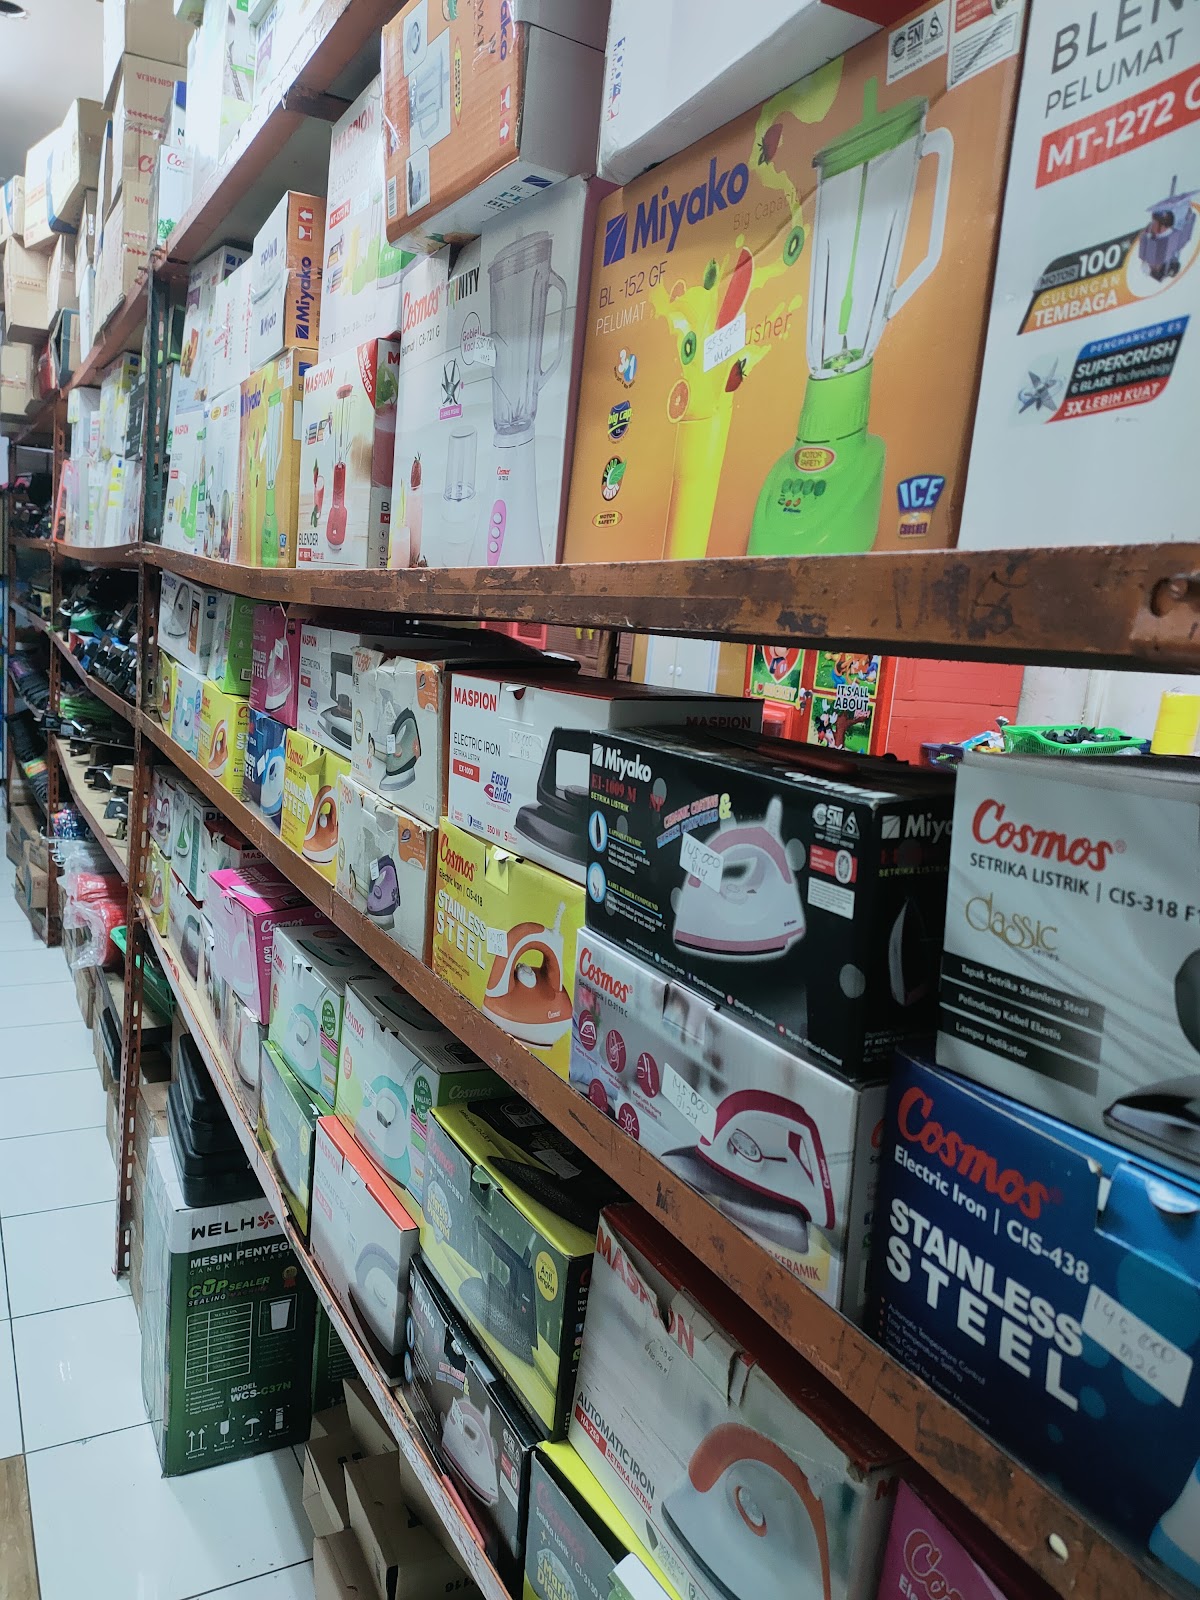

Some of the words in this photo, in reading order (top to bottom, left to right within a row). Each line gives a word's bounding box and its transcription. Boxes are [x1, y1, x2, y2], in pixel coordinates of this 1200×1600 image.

[1045, 27, 1184, 119] PELUMAT
[1046, 91, 1176, 173] MT-1272
[631, 156, 749, 254] Miyako
[296, 256, 314, 322] Miyako
[599, 285, 616, 309] BL
[647, 260, 668, 289] GF
[402, 290, 440, 336] Cosmos
[596, 301, 648, 336] PELUMAT
[1034, 290, 1119, 327] TEMBAGA
[745, 312, 793, 346] usher
[1075, 339, 1177, 379] SUPERCRUSH
[305, 367, 336, 395] MASPION
[1080, 372, 1114, 393] BLADE
[1064, 400, 1084, 417] 3X
[1085, 390, 1122, 411] LEBIH
[1124, 382, 1161, 401] KUAT
[801, 450, 823, 460] MOTOR
[801, 458, 821, 468] SAFETY
[899, 477, 945, 508] ICE
[298, 532, 319, 546] BLENDER
[598, 518, 615, 526] SAFETY
[454, 687, 497, 712] MASPION
[834, 698, 869, 712] ABOUT
[836, 685, 853, 698] IT'S
[854, 686, 869, 698] ALL
[686, 716, 751, 729] MASPION
[454, 732, 482, 752] ELECTRIC
[483, 741, 501, 757] IRON
[491, 771, 510, 790] Easy
[604, 747, 652, 784] Miyako
[494, 786, 512, 805] Glide
[590, 792, 610, 806] SETRIKA
[611, 798, 630, 813] LISTRIK
[826, 809, 844, 827] SNI
[904, 813, 952, 844] Miya
[971, 798, 1114, 872] Cosmos
[242, 852, 265, 860] MASP
[440, 833, 475, 882] Cosmos
[970, 852, 1028, 881] SETRIKA
[1032, 868, 1090, 897] LISTRIK
[1109, 887, 1178, 919] CIS-318
[438, 889, 486, 942] STAINLESS
[436, 910, 486, 971] STEEL
[579, 947, 629, 1004] Cosmos
[961, 963, 985, 981] Tapak
[986, 973, 1018, 993] Setrika
[1020, 984, 1062, 1009] Stainless
[1063, 1000, 1091, 1018] Steel
[958, 993, 1002, 1021] Pelindung
[1002, 1009, 1030, 1028] Kabel
[1030, 1020, 1062, 1042] Elastis
[955, 1021, 985, 1042] Lampu
[986, 1033, 1029, 1059] Indikator
[897, 1086, 1050, 1220] Cosmos
[894, 1144, 950, 1197] Electric
[951, 1183, 988, 1222] Iron
[1006, 1219, 1090, 1286] CIS-438
[190, 1252, 232, 1269] MESIN
[889, 1198, 1084, 1358] STAINLESS
[187, 1279, 228, 1299] CUP
[228, 1276, 270, 1292] SEALER
[188, 1294, 227, 1308] SEALING
[886, 1236, 1079, 1412] STEEL
[230, 1381, 292, 1403] WCS-C37N
[231, 1382, 258, 1394] MODEL
[577, 1391, 630, 1465] AUTOMATIC
[630, 1457, 655, 1500] IRON
[606, 1448, 630, 1484] SETRIKA
[630, 1478, 653, 1514] LISTRIK
